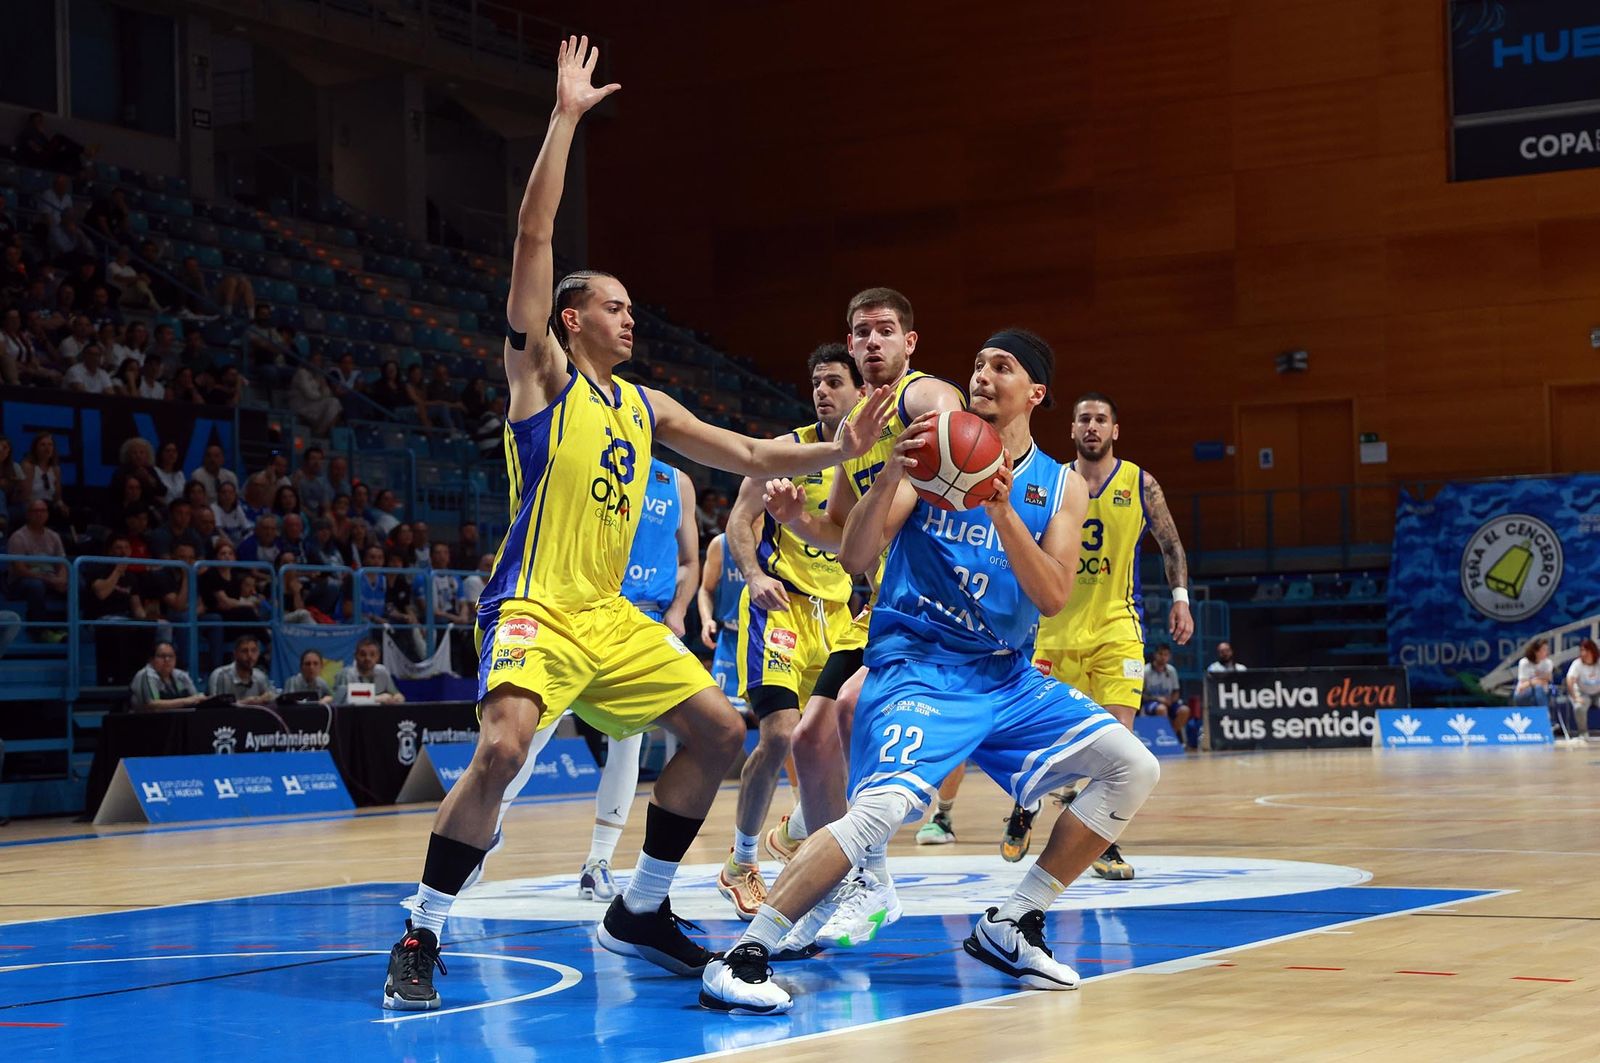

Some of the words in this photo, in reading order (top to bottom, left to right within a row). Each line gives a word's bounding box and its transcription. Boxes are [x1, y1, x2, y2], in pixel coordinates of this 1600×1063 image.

[1519, 130, 1594, 160] COPA
[1025, 497, 1043, 505] PLATA
[595, 508, 621, 534] GLBAL
[804, 544, 839, 563] OC
[1467, 547, 1486, 590] PEÑA
[1484, 529, 1500, 545] EL
[1505, 522, 1555, 588] CENCERRO
[1399, 639, 1491, 667] CIUDAD
[1218, 681, 1319, 710] Huelva
[1326, 677, 1397, 707] eleva
[1220, 713, 1266, 741] tus
[1272, 709, 1376, 738] sentido
[245, 730, 330, 751] Ayuntamiento
[879, 723, 924, 766] 22
